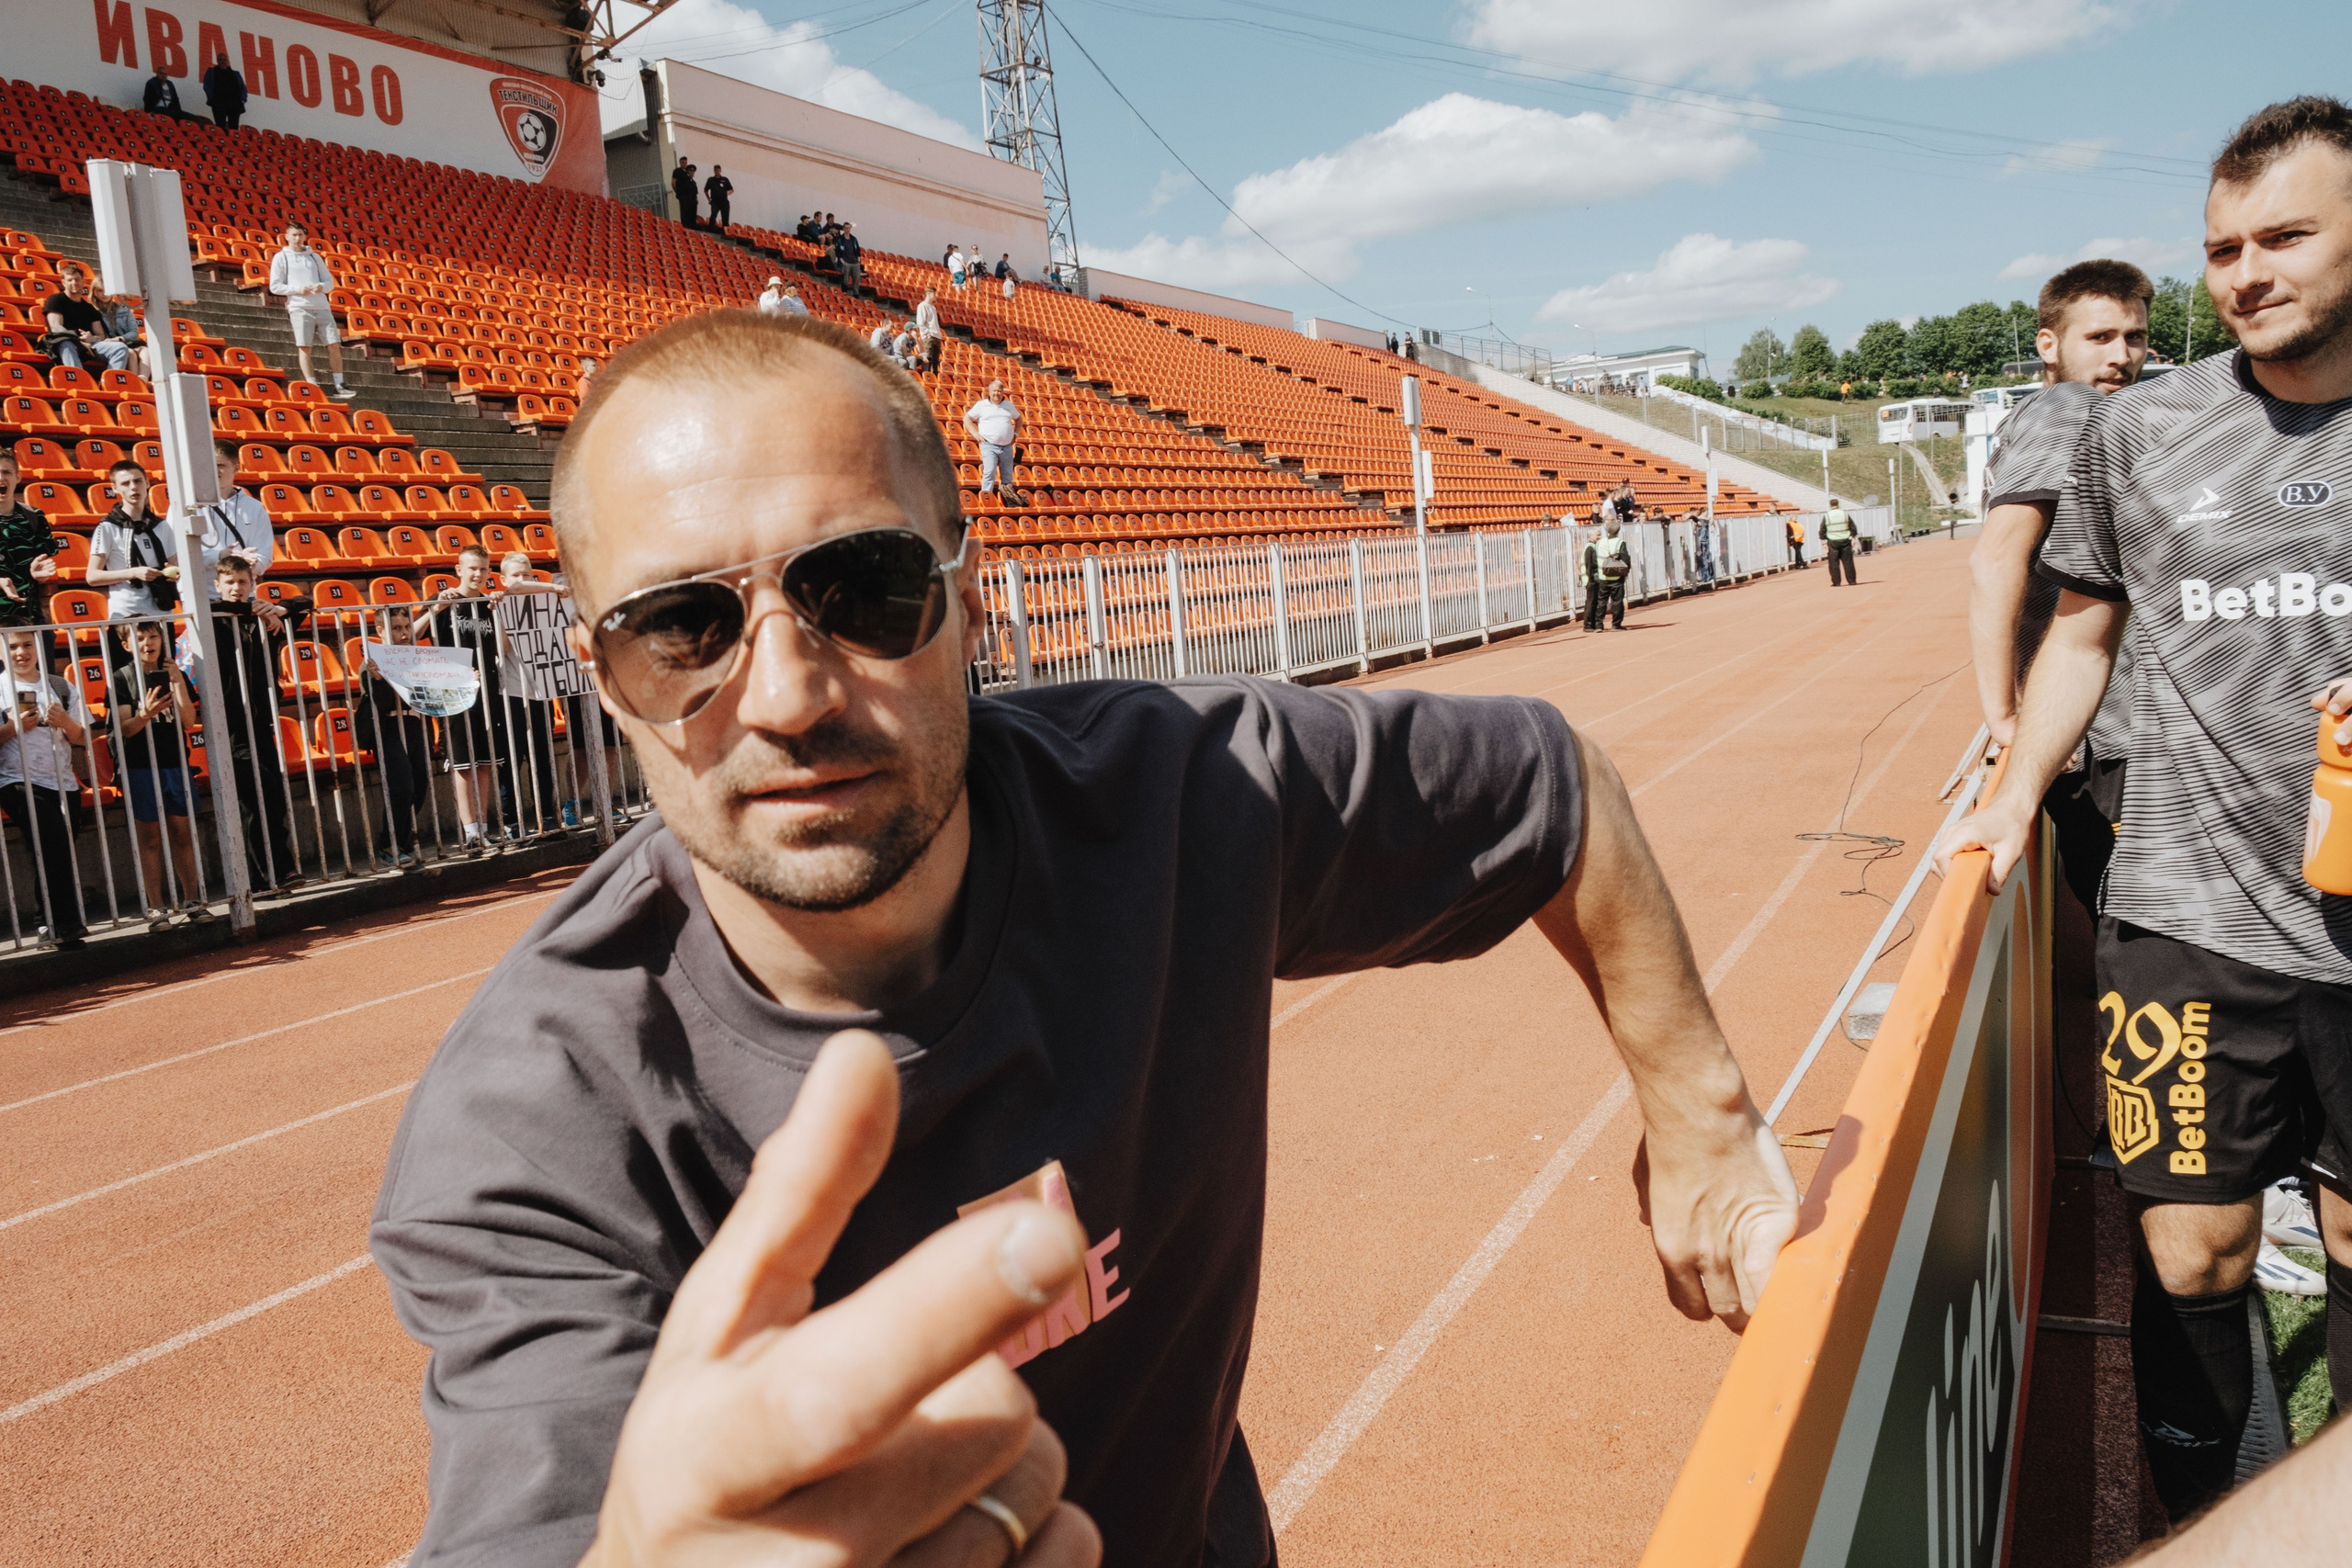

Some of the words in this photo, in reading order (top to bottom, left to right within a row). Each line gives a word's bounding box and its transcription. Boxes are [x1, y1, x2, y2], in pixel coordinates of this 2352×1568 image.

[95, 0, 404, 126] ИВАНОВО
[497, 89, 559, 115] ТЕКСТИЛЬЩИК
[527, 164, 543, 173] 1937
[42, 488, 52, 496] 29
[2176, 510, 2233, 524] DEMIX
[56, 538, 68, 547] 28
[269, 589, 280, 597] 30
[74, 604, 85, 614] 27
[300, 649, 311, 658] 29
[399, 657, 407, 665] НЕ
[87, 668, 100, 678] 26
[335, 719, 346, 729] 28
[191, 734, 204, 745] 26
[2098, 991, 2182, 1086] 29
[2169, 1001, 2211, 1175] BetBoom
